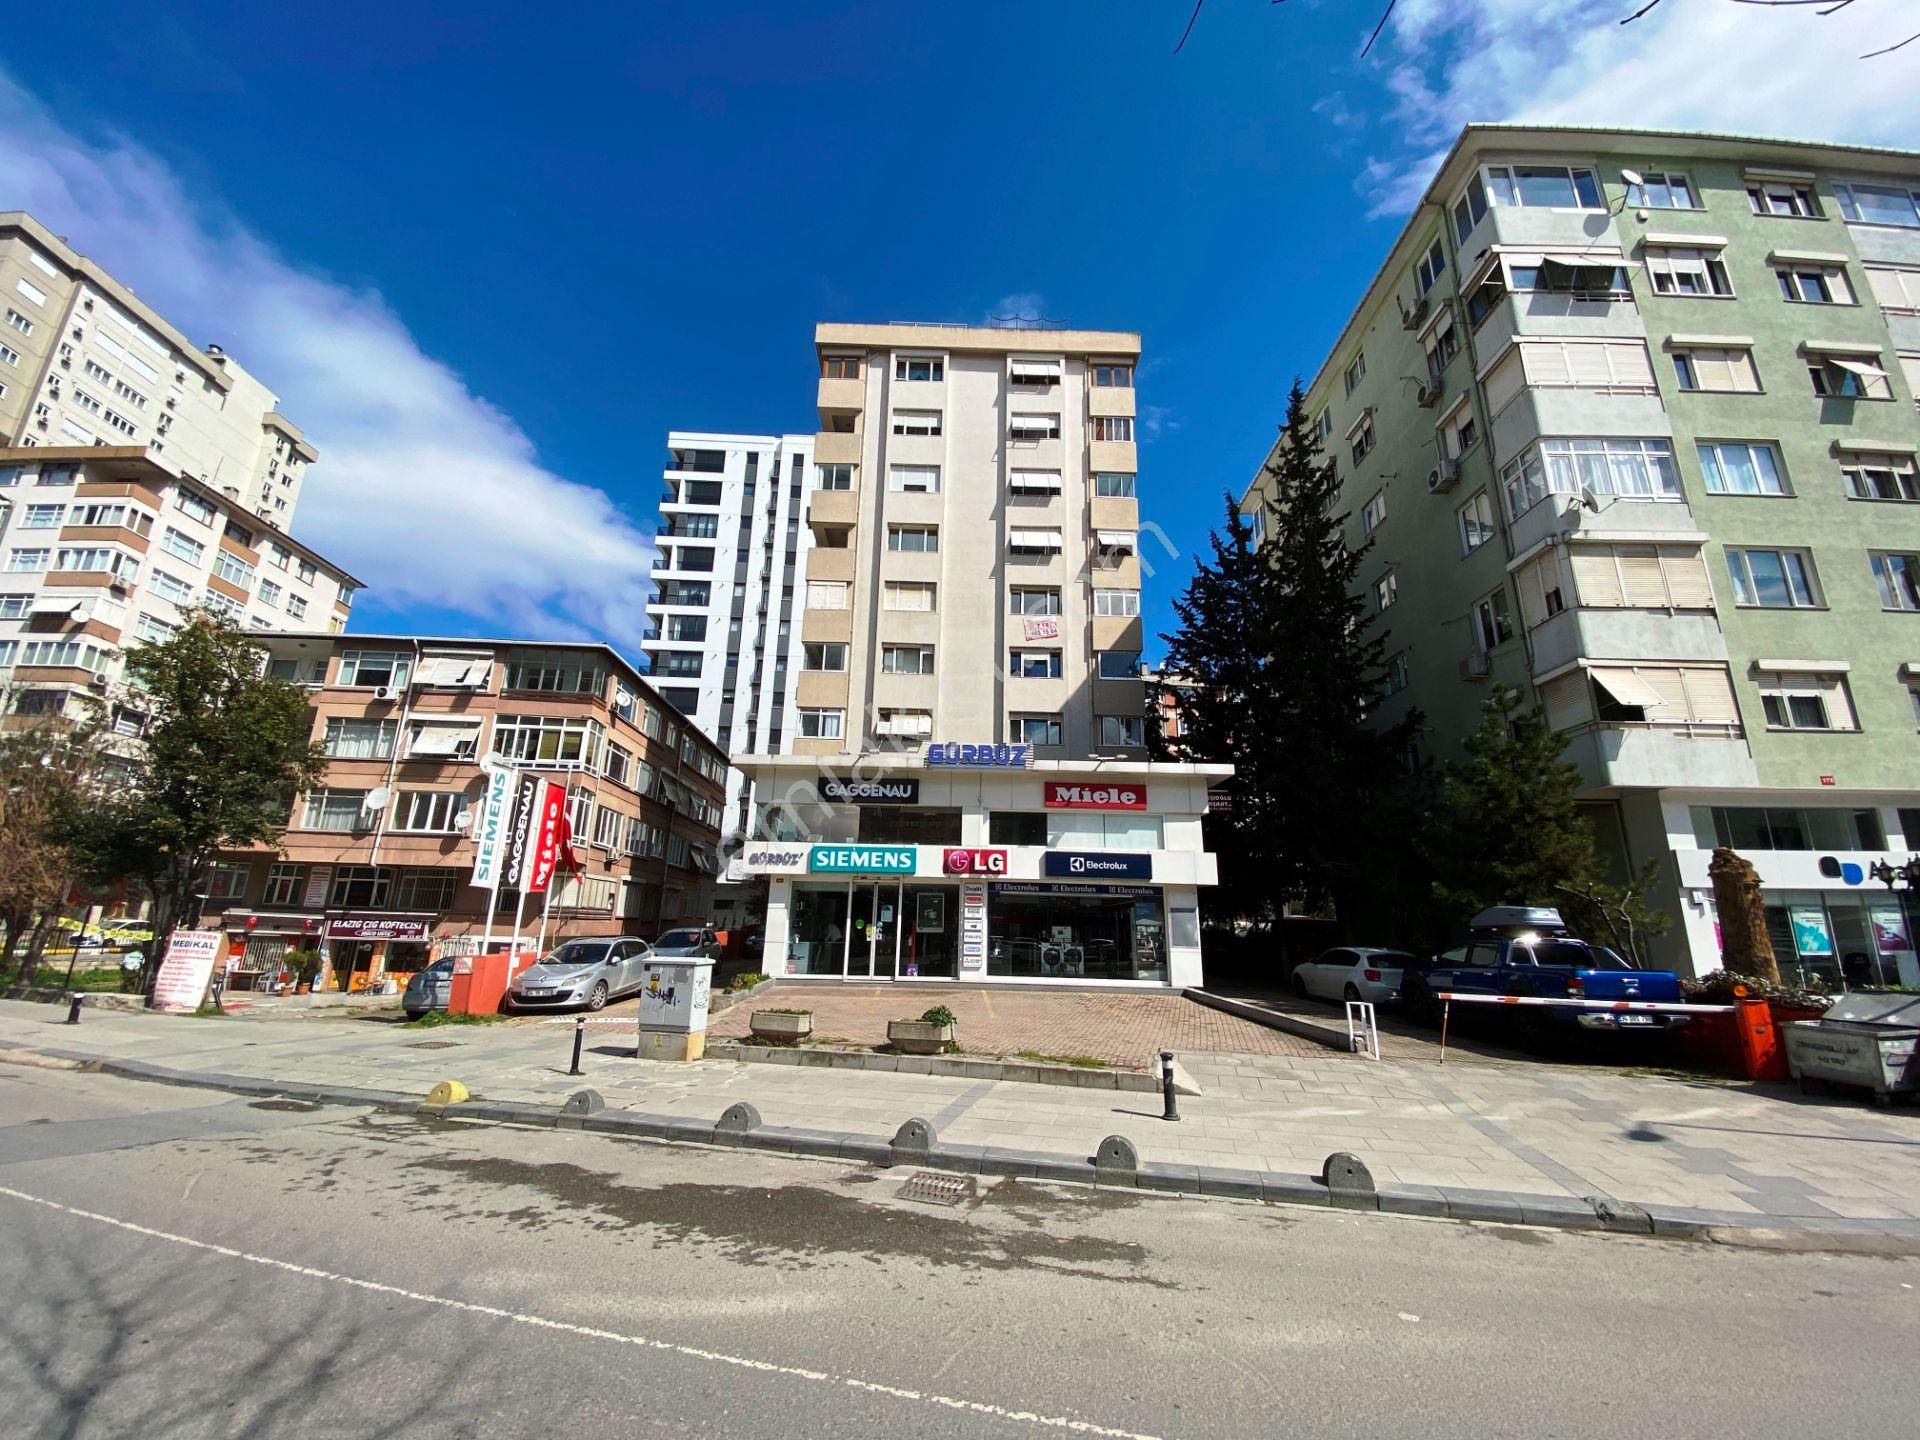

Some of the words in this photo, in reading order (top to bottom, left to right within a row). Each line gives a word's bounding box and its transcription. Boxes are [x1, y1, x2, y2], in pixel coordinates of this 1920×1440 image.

[928, 742, 1026, 765] GÜRBÜZ
[825, 783, 912, 798] GAGGENAU
[1055, 787, 1136, 804] Miele
[478, 773, 506, 880] SIEMENS
[509, 781, 533, 884] GAGGENAU
[535, 803, 557, 886] Miele
[817, 851, 911, 868] SIEMENS
[974, 853, 1004, 871] LG
[1086, 860, 1128, 871] Electrolux
[1003, 883, 1040, 892] Electrolux
[1061, 884, 1096, 893] Electrolux
[1117, 886, 1154, 895] Electrolux
